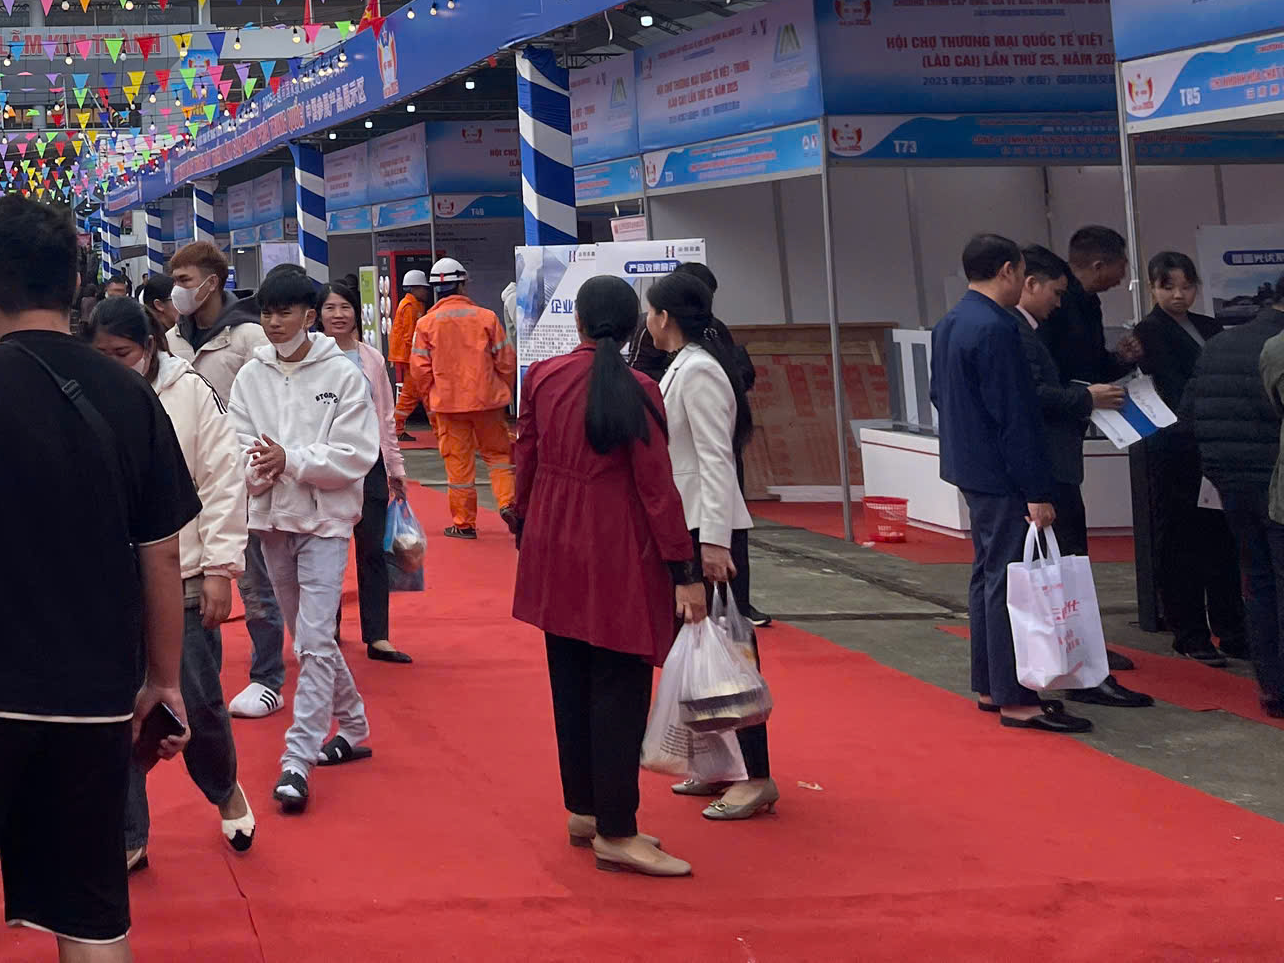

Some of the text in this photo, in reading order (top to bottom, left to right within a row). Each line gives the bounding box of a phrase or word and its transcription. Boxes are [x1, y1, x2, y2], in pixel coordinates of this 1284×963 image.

[92, 27, 161, 55] TÀNH
[885, 34, 908, 51] HỘI
[911, 36, 937, 51] CHỢ
[939, 34, 991, 49] THƯƠNG
[994, 34, 1019, 51] MẠI
[1021, 31, 1057, 48] QUỐC
[1077, 31, 1105, 49] VIỆT
[922, 52, 951, 69] (LÀO
[1062, 50, 1093, 66] NĂM
